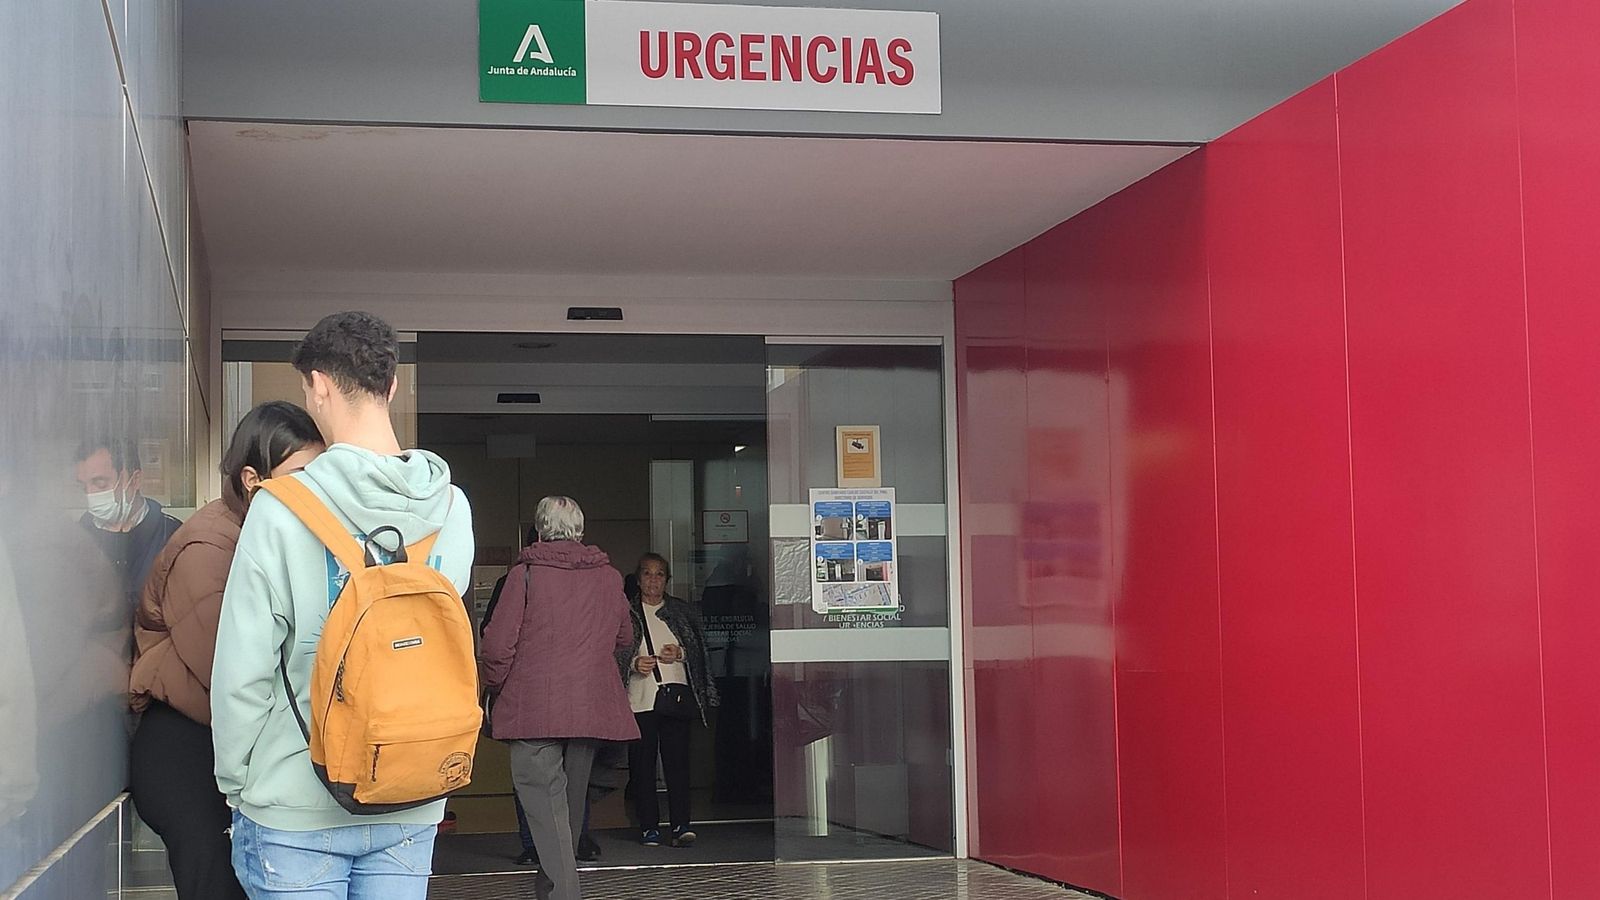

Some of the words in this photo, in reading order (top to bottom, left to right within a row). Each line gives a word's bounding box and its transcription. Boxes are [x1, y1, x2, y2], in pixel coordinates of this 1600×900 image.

[638, 29, 915, 86] URGENCIAS
[488, 66, 515, 75] Junta
[517, 67, 529, 75] de
[530, 66, 577, 77] Andalucía
[828, 614, 872, 622] BIENESTAR
